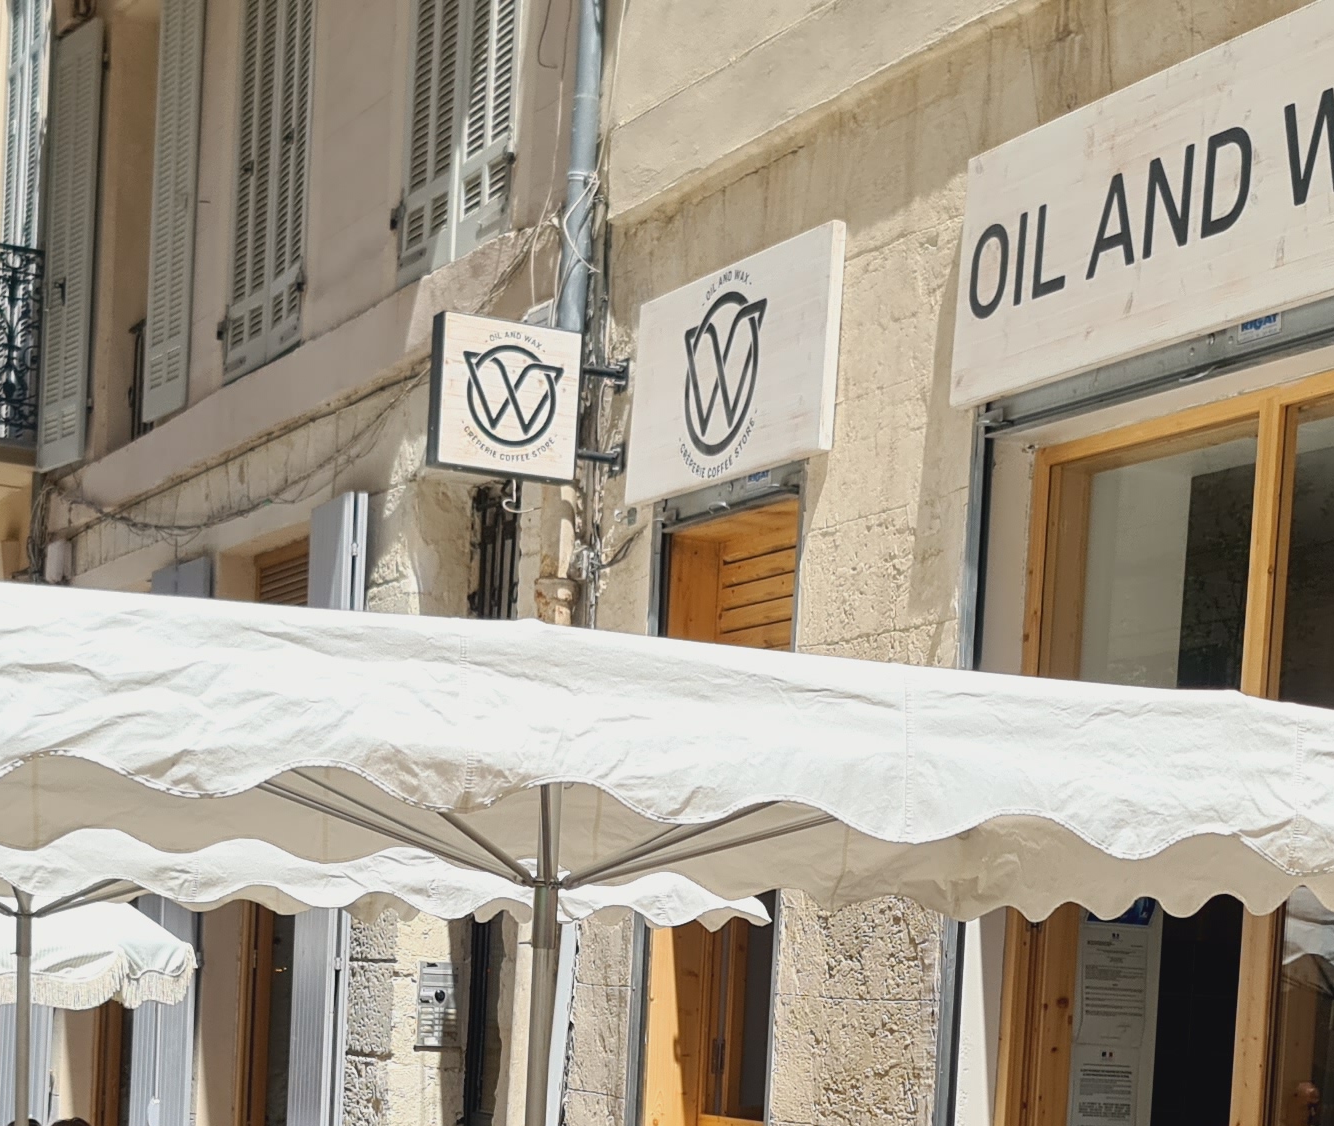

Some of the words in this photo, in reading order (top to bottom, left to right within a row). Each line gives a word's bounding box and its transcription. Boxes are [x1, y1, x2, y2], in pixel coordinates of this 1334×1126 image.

[970, 203, 1066, 319] OIL
[1085, 126, 1252, 280] AND
[705, 283, 717, 301] OIL
[718, 272, 733, 286] AND
[734, 269, 750, 285] WAX
[489, 331, 503, 342] OIL
[504, 330, 522, 340] AND
[524, 335, 542, 351] WAX
[499, 453, 530, 463] COFFEE
[532, 438, 555, 459] STORE
[707, 456, 734, 480] COFFEE
[734, 419, 756, 460] STORE
